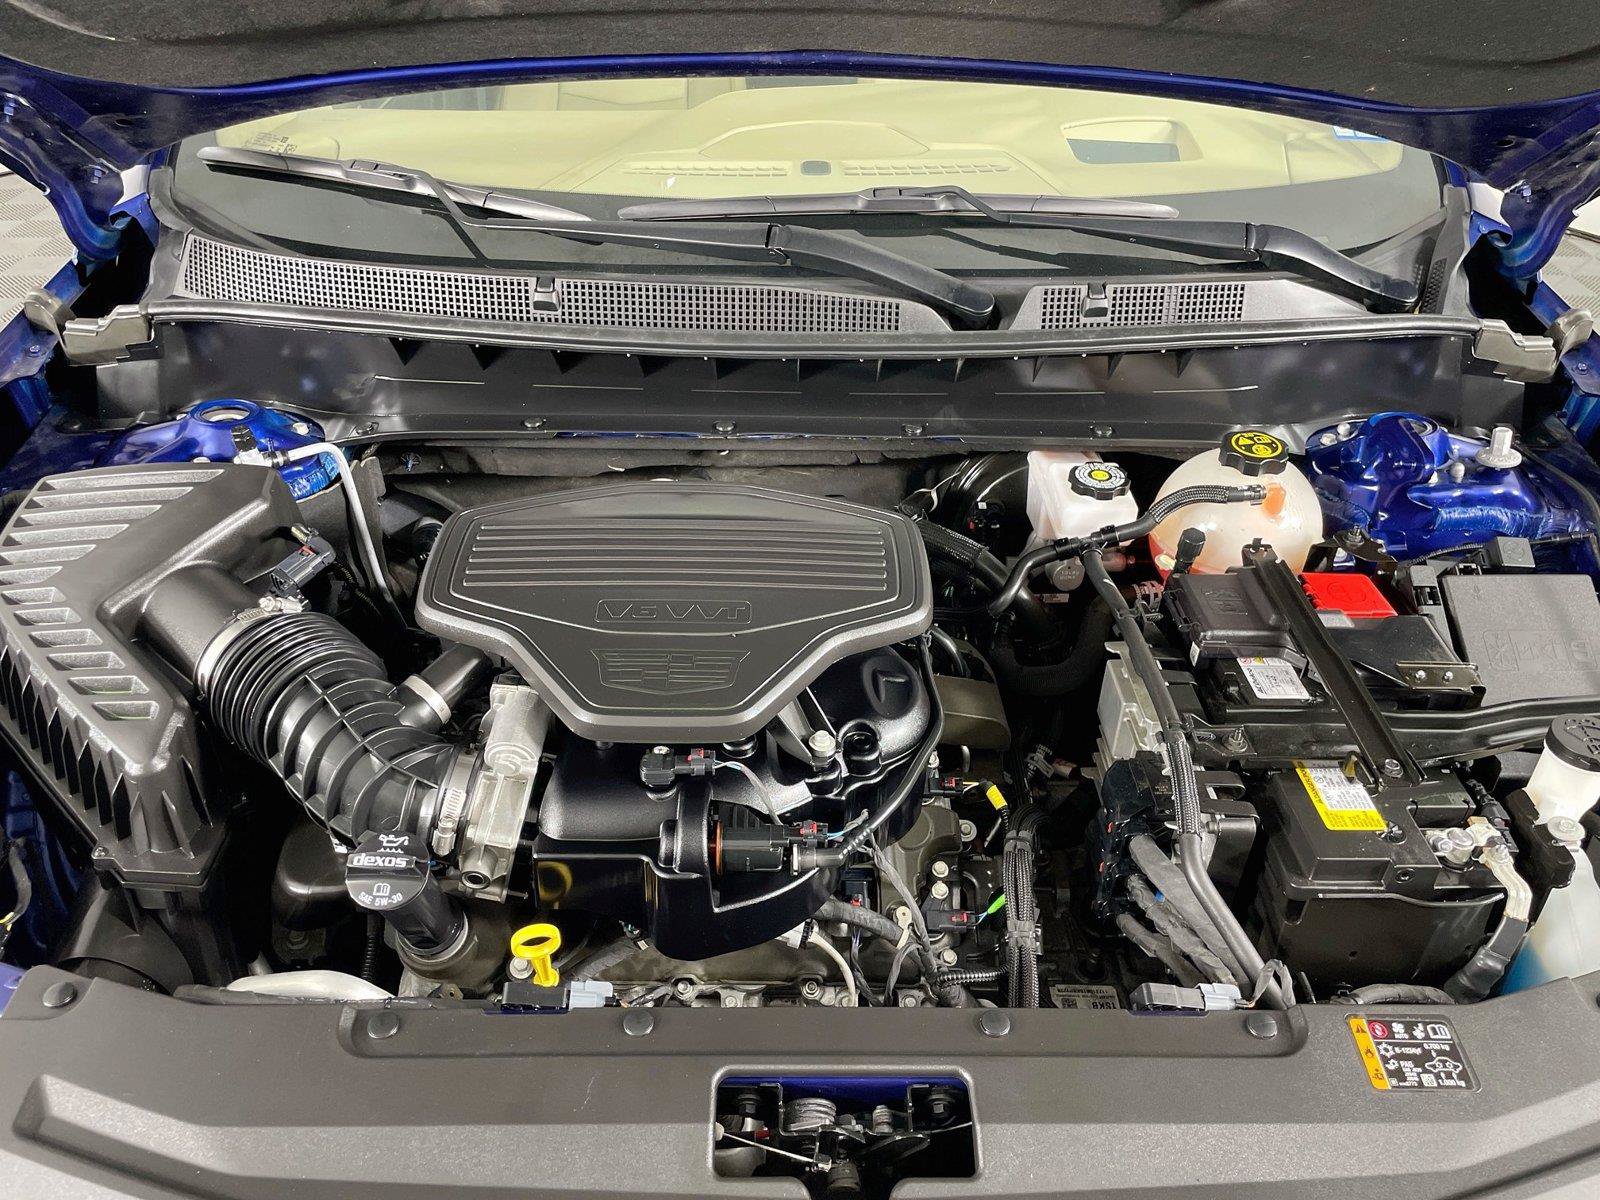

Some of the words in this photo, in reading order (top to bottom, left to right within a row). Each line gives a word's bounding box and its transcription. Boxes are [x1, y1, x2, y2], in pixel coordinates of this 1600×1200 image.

[604, 603, 657, 618] V6
[666, 603, 746, 619] VVT
[352, 852, 410, 868] dexos
[358, 891, 374, 905] SAE
[374, 892, 403, 907] 5W-30
